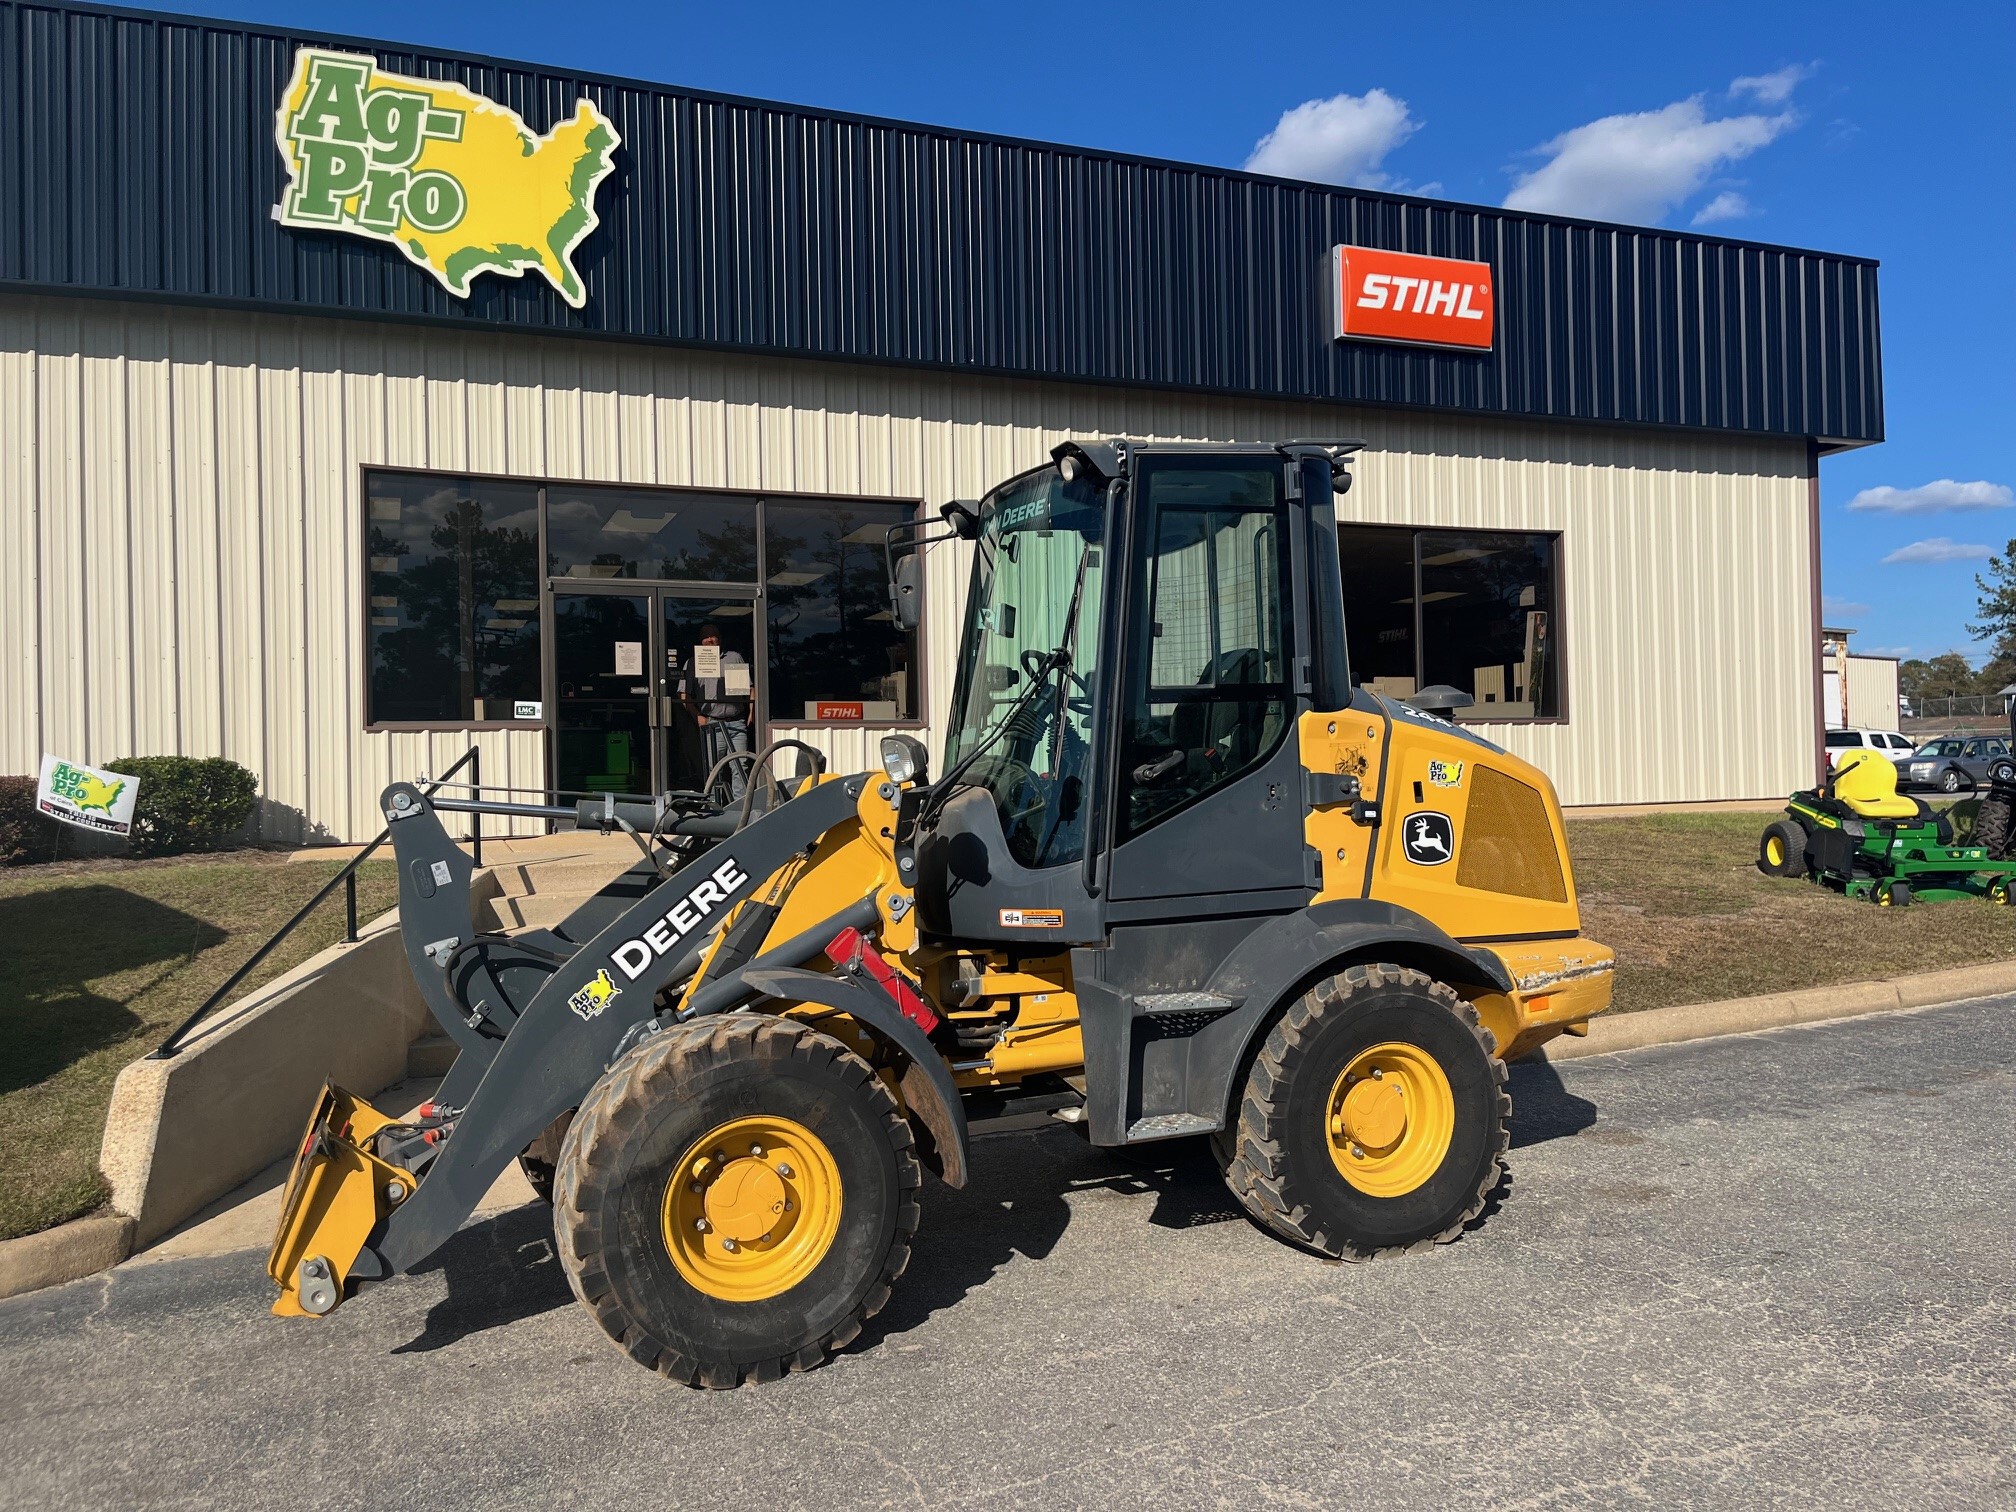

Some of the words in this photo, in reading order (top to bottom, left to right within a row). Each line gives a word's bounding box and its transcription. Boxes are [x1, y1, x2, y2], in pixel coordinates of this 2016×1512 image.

[292, 59, 463, 168] Ag-
[291, 139, 465, 231] Pro
[1001, 497, 1047, 528] DEERE
[821, 707, 860, 718] STIHL
[53, 762, 91, 786] Ag-
[1430, 770, 1448, 781] Pro
[52, 779, 88, 800] Pro
[49, 808, 75, 821] SYRUP
[611, 857, 749, 981] DEERE
